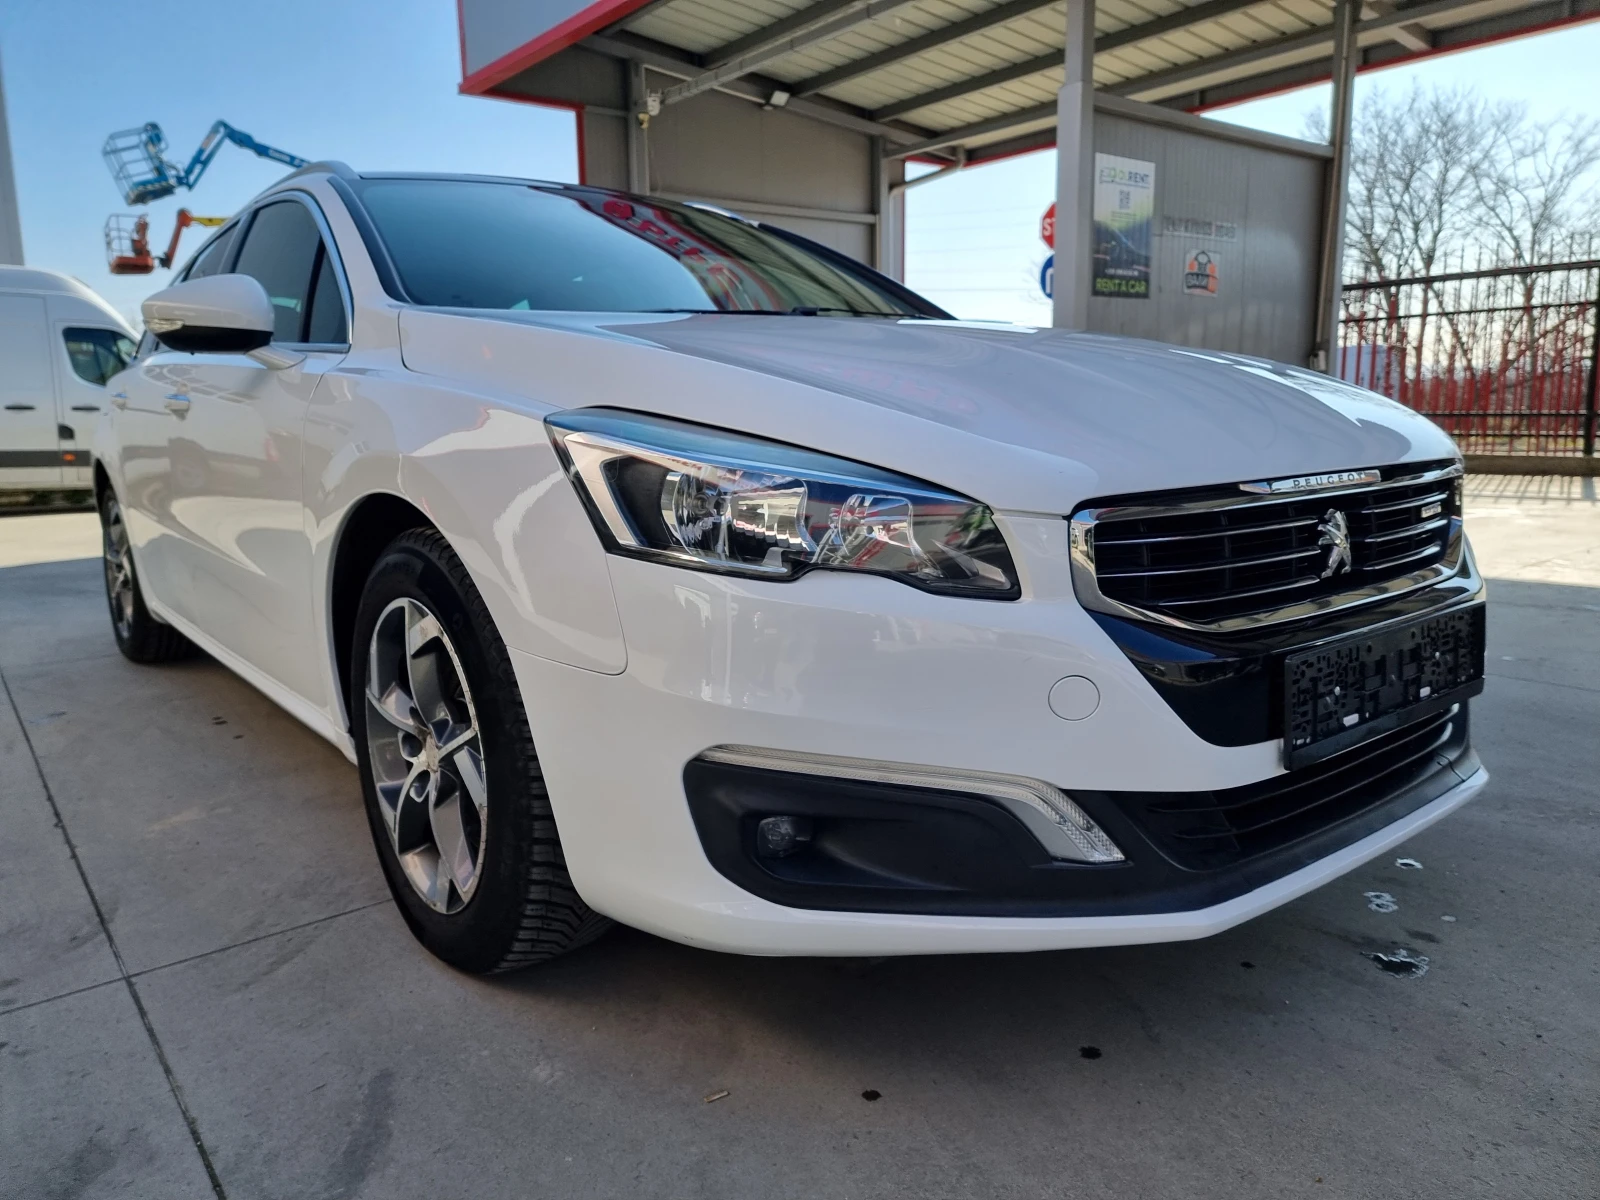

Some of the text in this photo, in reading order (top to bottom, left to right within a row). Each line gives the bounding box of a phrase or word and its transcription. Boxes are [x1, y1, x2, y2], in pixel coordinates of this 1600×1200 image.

[1096, 277, 1119, 291] RENT
[1128, 280, 1147, 293] CAR
[1293, 472, 1365, 488] PEUGEOT
